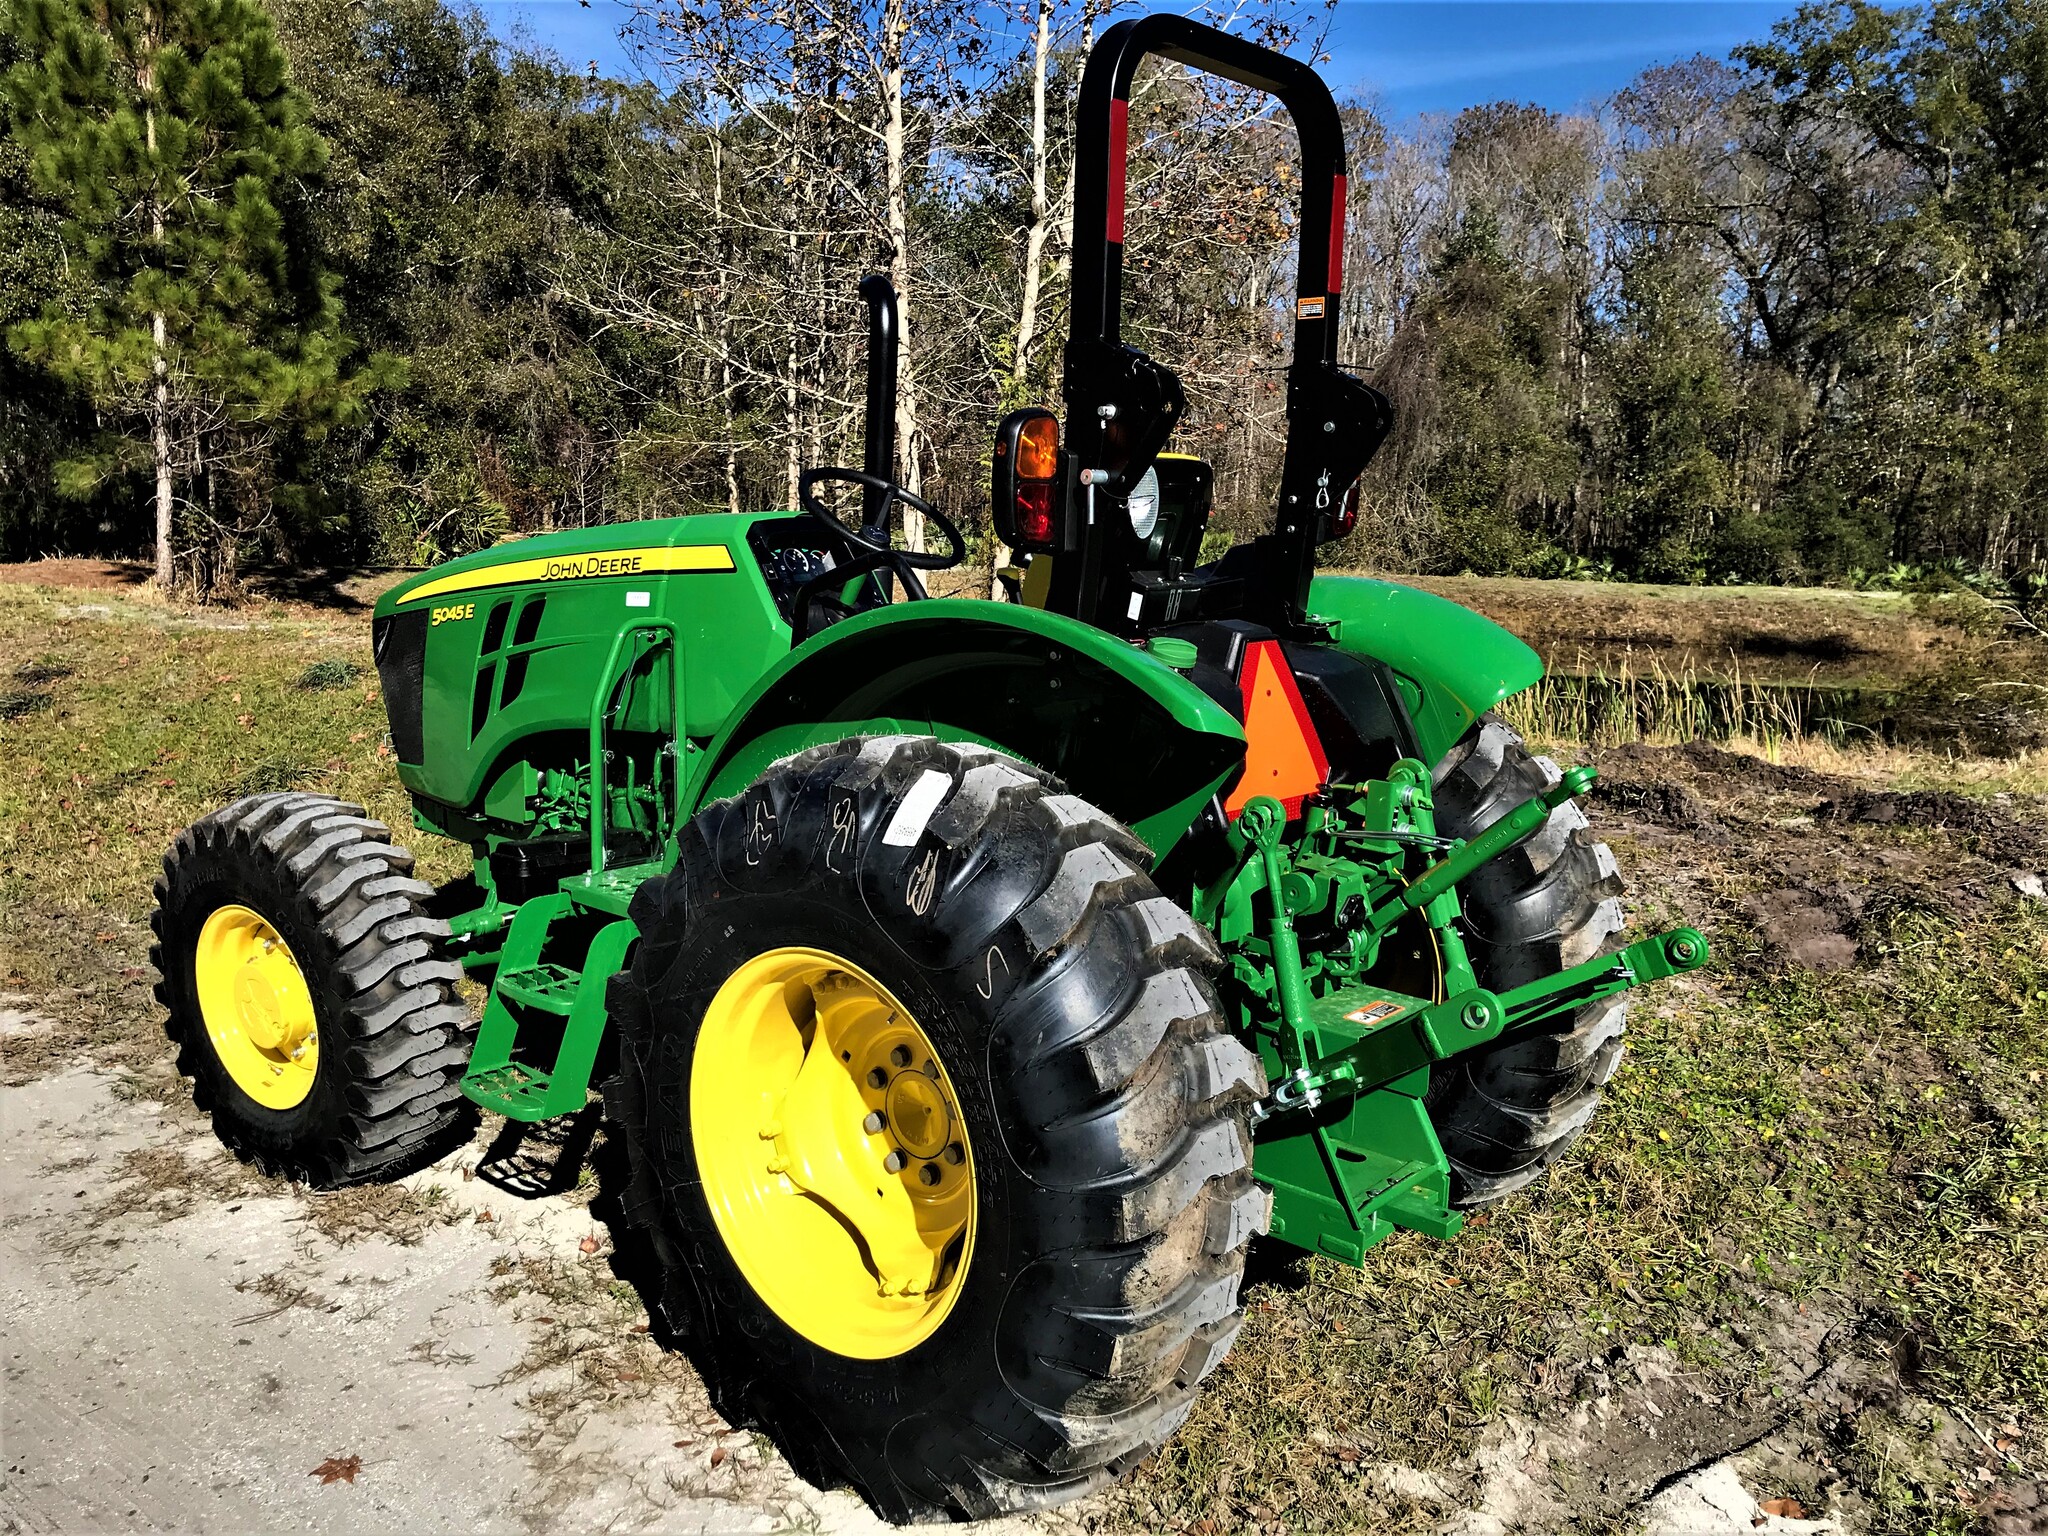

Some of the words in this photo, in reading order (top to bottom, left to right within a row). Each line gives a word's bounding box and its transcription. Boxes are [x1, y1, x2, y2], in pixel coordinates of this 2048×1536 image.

[541, 562, 583, 578] JOHN
[587, 557, 642, 574] DEERE
[431, 605, 465, 626] 5045
[465, 603, 475, 619] E
